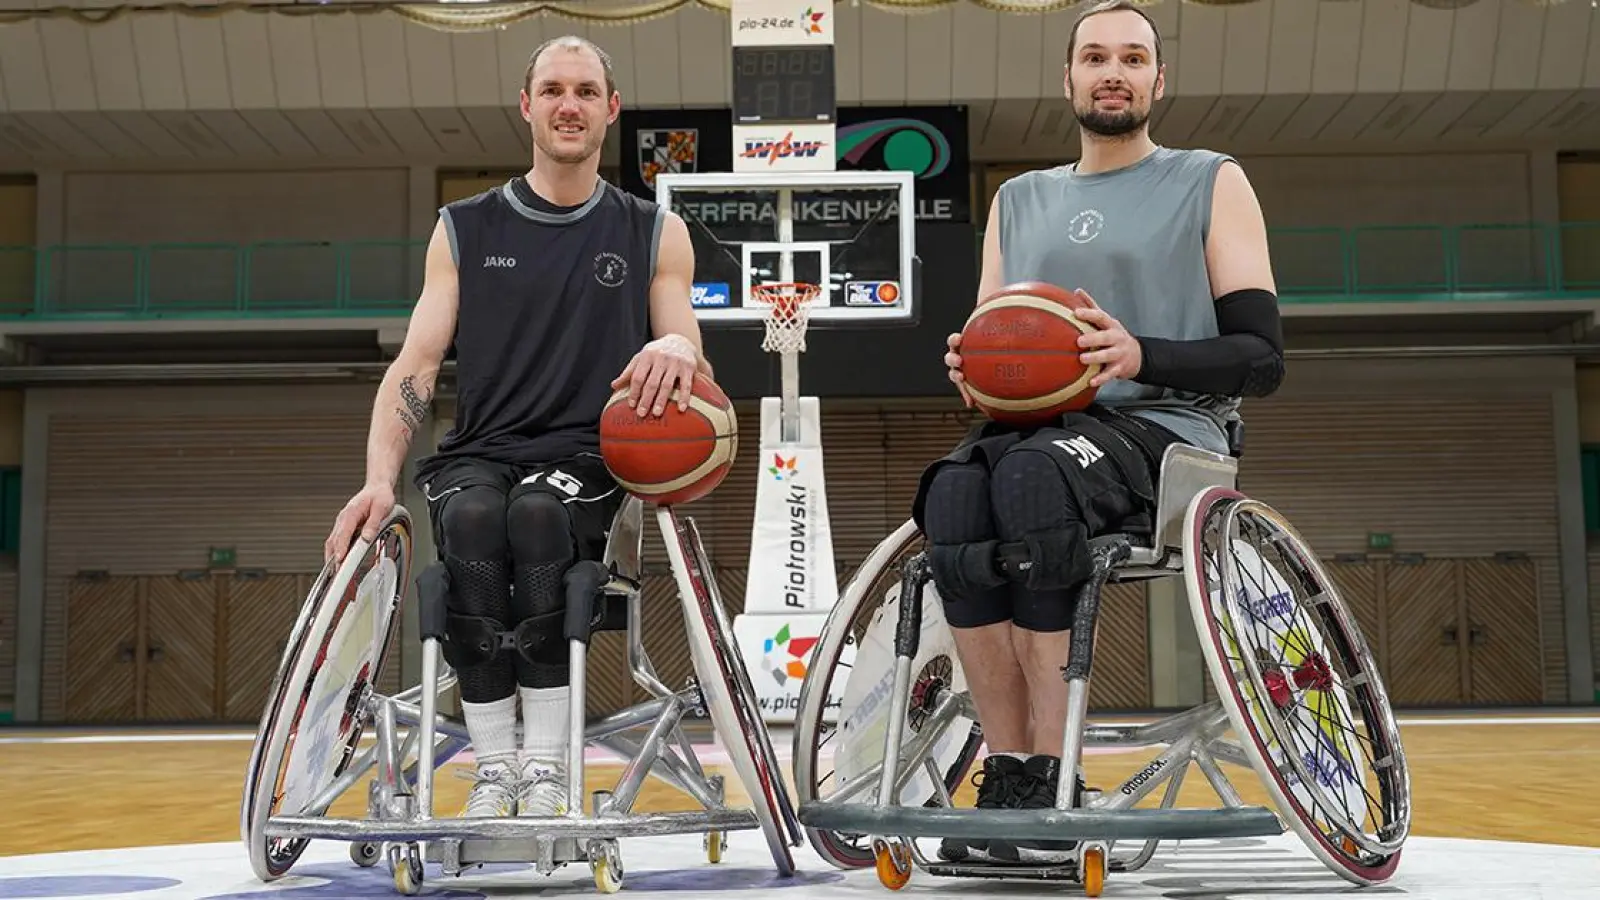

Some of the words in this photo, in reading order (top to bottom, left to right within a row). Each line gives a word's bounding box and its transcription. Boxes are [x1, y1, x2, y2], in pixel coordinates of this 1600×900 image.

[739, 17, 795, 31] pio-24.de
[671, 199, 952, 222] ERFRAKENHALE
[483, 256, 517, 268] JAKO
[785, 485, 807, 608] Piotrowski
